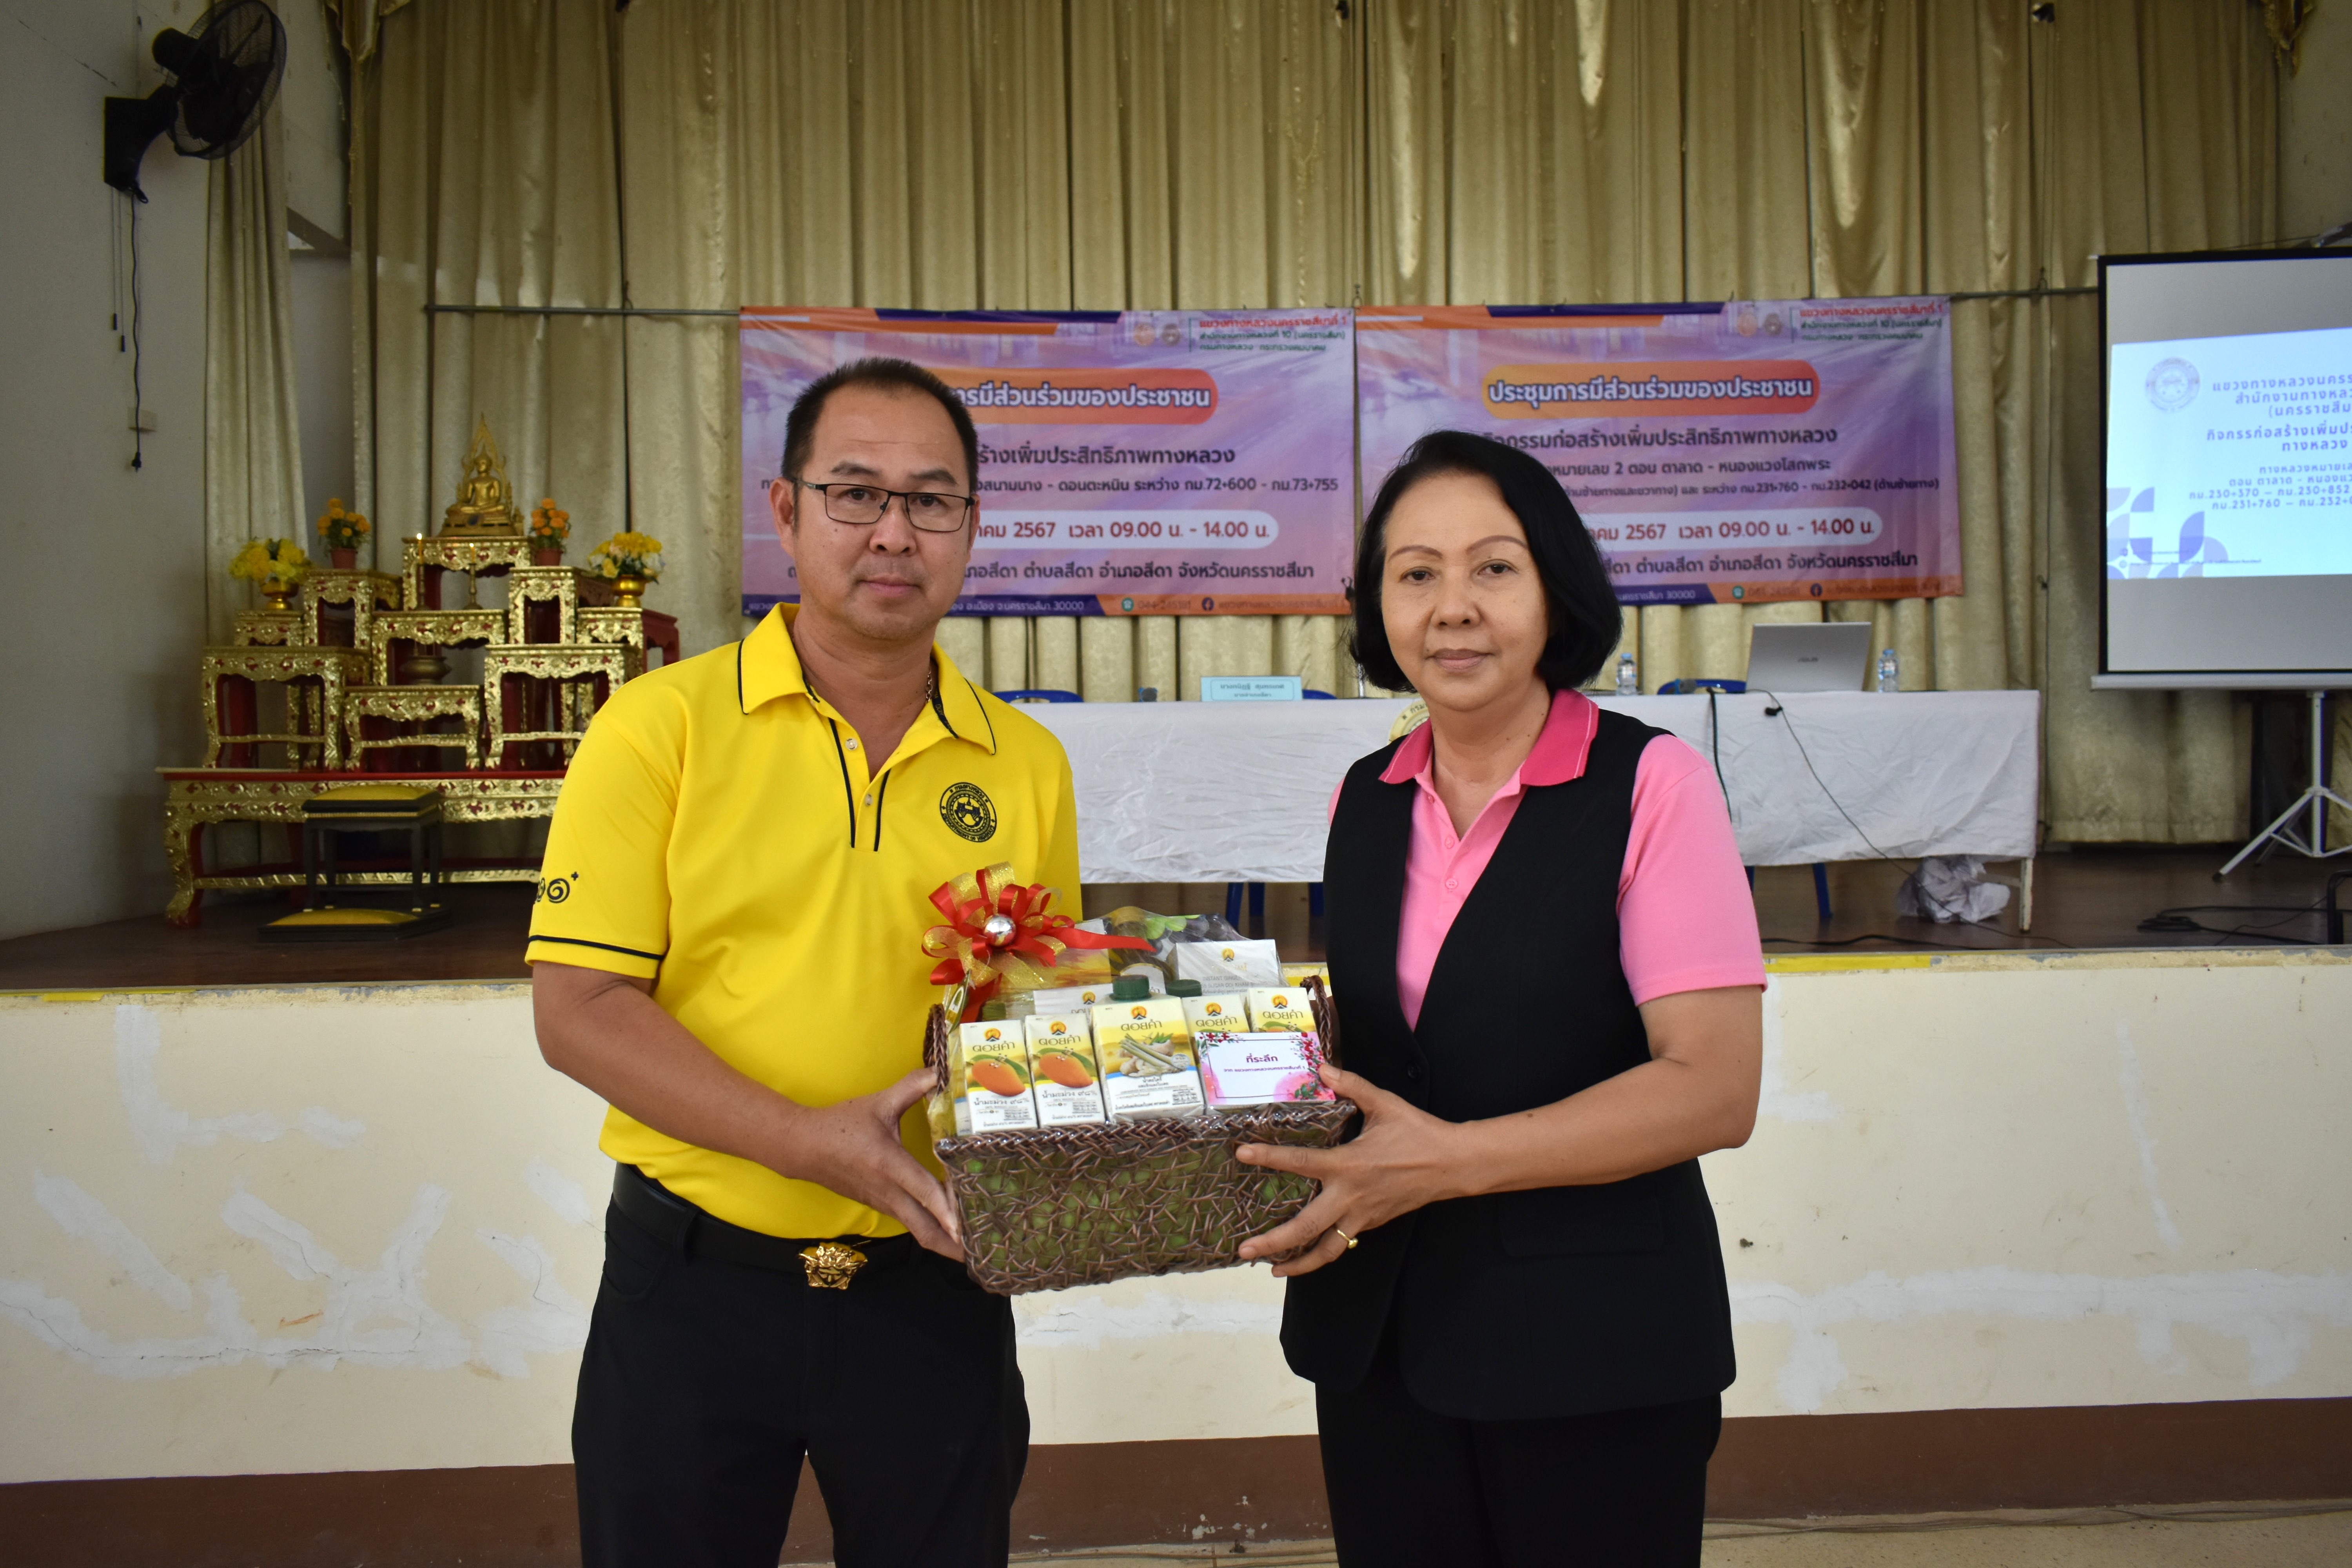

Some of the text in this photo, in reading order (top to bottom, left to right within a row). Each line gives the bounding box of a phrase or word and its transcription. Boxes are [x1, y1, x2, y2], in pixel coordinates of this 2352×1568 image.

[954, 381, 1211, 407] ารมีส่วนร่วมของประชาชน
[1489, 375, 1814, 409] ประชุมการมีส่วนร่วมของประชาชน
[2282, 439, 2348, 452] ทางหลวง
[980, 441, 1235, 465] ร้างเพิ่มประสิทธิภาพทางหลวง
[1615, 462, 1623, 475] 2
[1628, 463, 1657, 475] ตอน
[1059, 477, 1129, 492] ดอนตะหนิน
[1135, 477, 1180, 491] ระหว่าง
[1014, 522, 1056, 537] 2567
[1069, 525, 1103, 538] เวลา
[1110, 522, 1161, 537] 09.00
[1169, 524, 1183, 537] น.
[1204, 521, 1249, 537] 14.00
[1256, 524, 1270, 537] น.
[1625, 524, 1666, 540] 2567
[1679, 526, 1712, 539] เวลา
[1719, 521, 1770, 538] 09.00
[1776, 522, 1791, 536] น.
[1811, 517, 1855, 534] 14.00
[1861, 520, 1875, 534] น.
[1636, 556, 1704, 573] ตำบลสีดา
[1710, 554, 1782, 572] อำเภอสีดา
[1788, 551, 1918, 569] จังหวัดนครราชสีมา
[1024, 562, 1093, 578] ตำบลสีดา
[1100, 561, 1172, 578] อำเภอสีดา
[1179, 561, 1314, 578] จังหวัดนครราชสีมา
[1053, 601, 1085, 610] 30000
[1262, 1009, 1304, 1019] ดอยคำ
[1121, 1019, 1163, 1031] ดอยคำ
[1196, 1015, 1238, 1027] ดอยคำ
[973, 1040, 1015, 1052] ดอยคำ
[1039, 1034, 1081, 1045] ดอยคำ
[1246, 1053, 1278, 1063] ที่ระลึก
[974, 1097, 1007, 1105] น้ำมะม่วง
